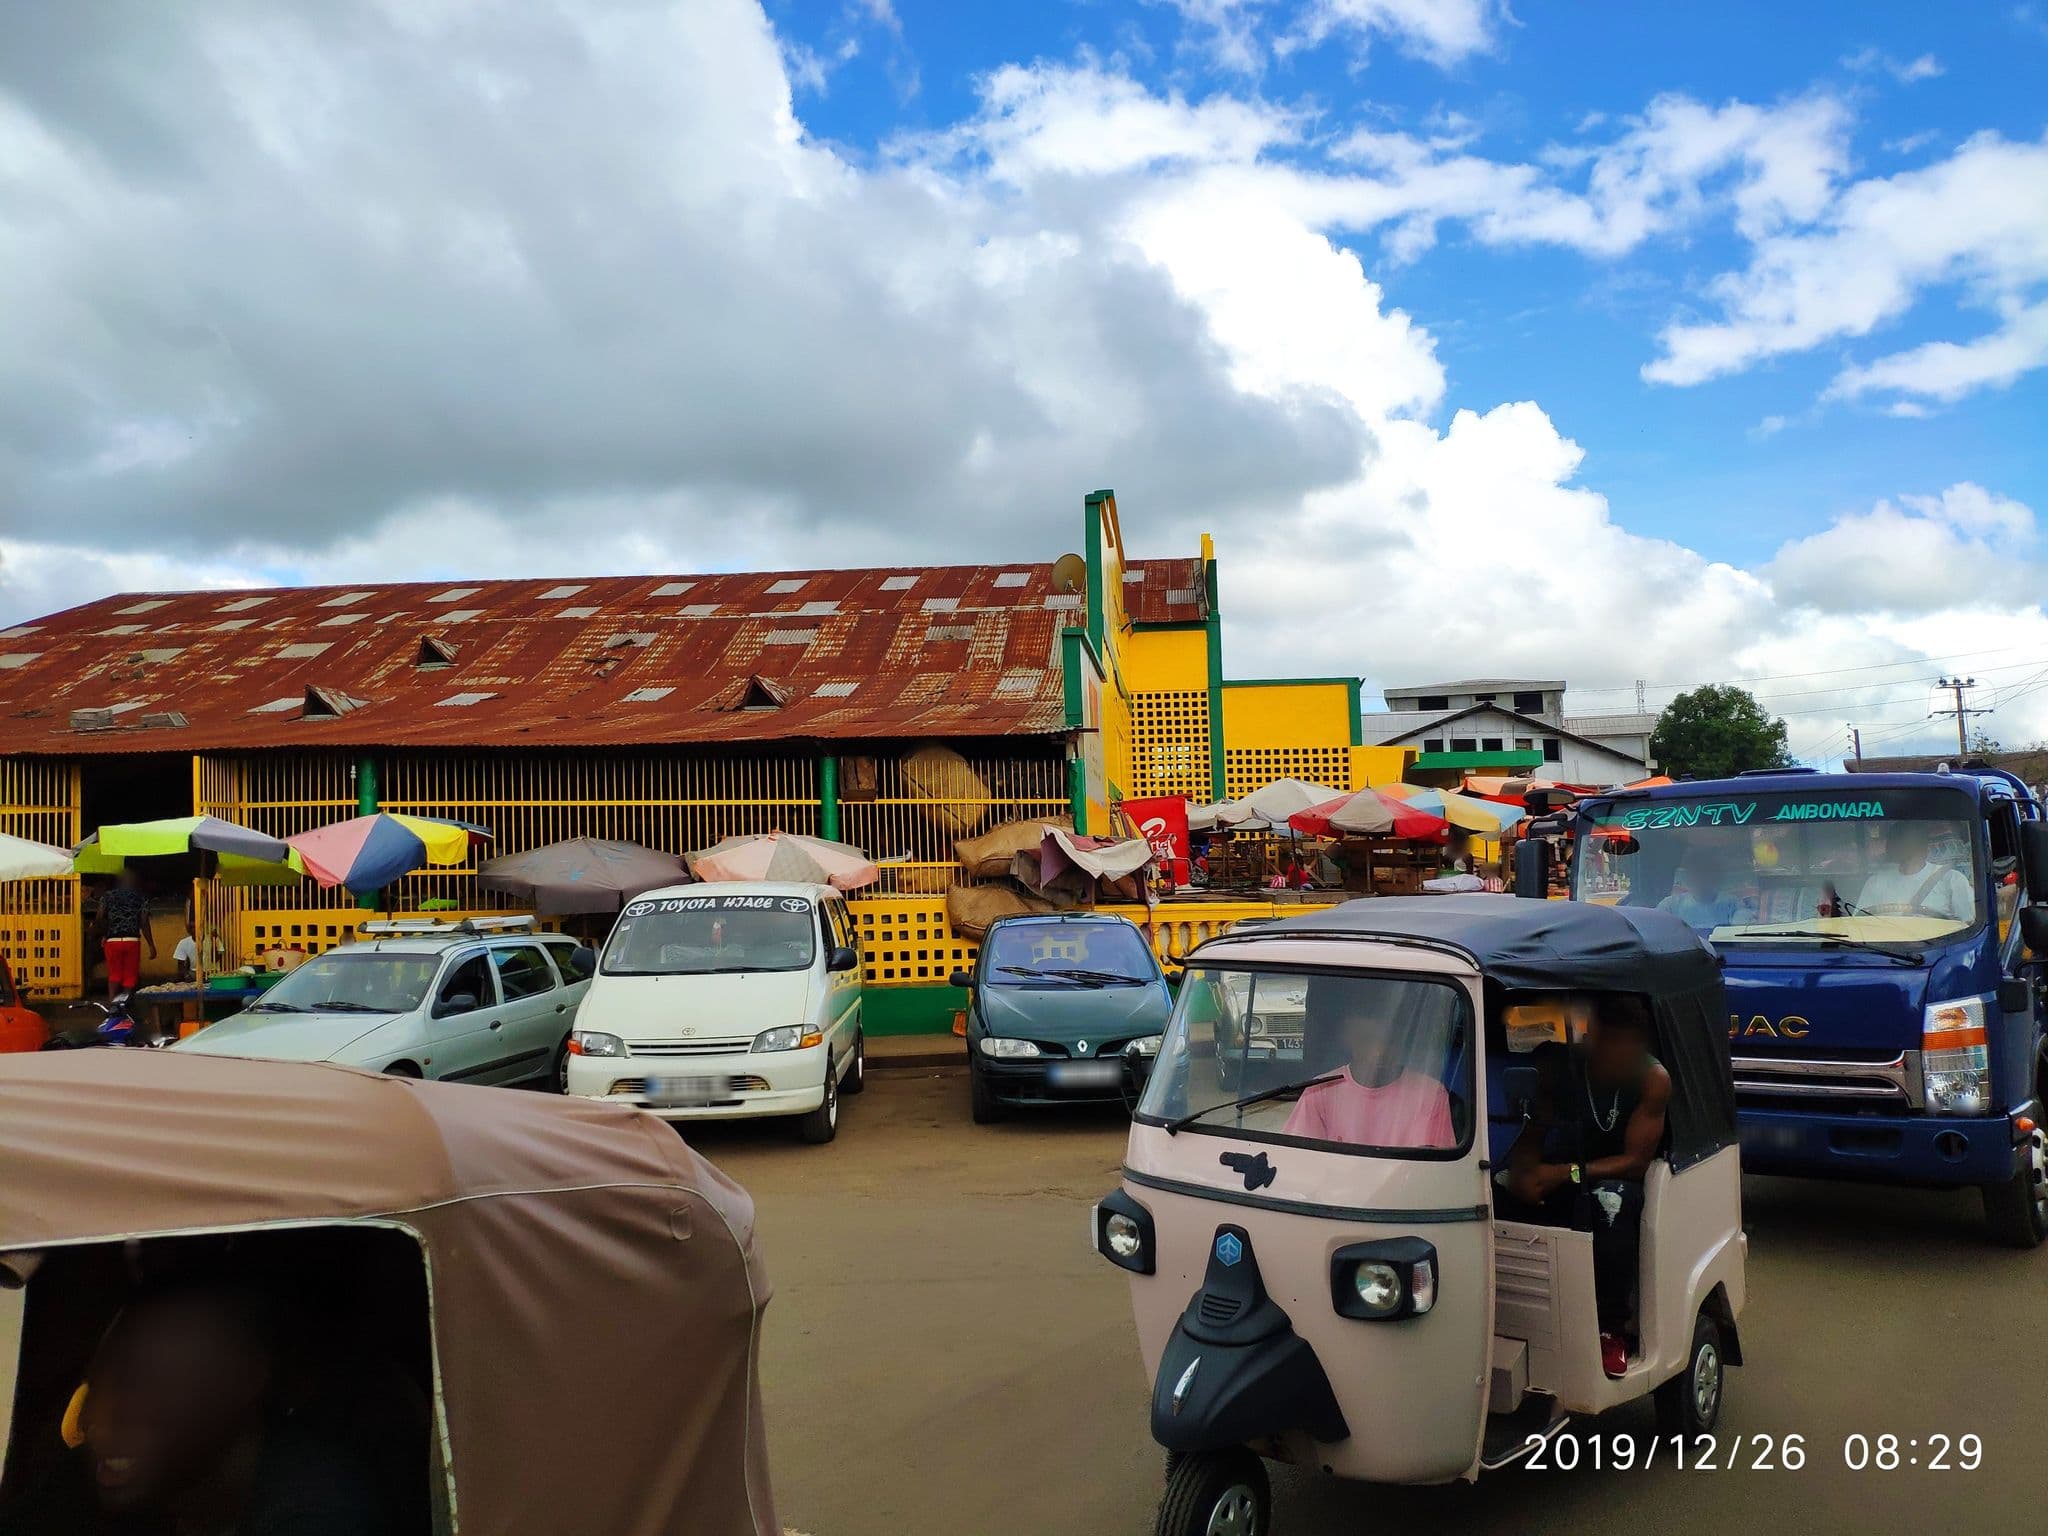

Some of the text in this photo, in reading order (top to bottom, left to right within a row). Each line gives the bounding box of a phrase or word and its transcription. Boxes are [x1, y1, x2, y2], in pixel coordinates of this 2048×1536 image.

[1775, 802, 1885, 820] AMBONARA
[659, 898, 717, 913] TOYOTA
[1728, 1014, 1810, 1039] JAC
